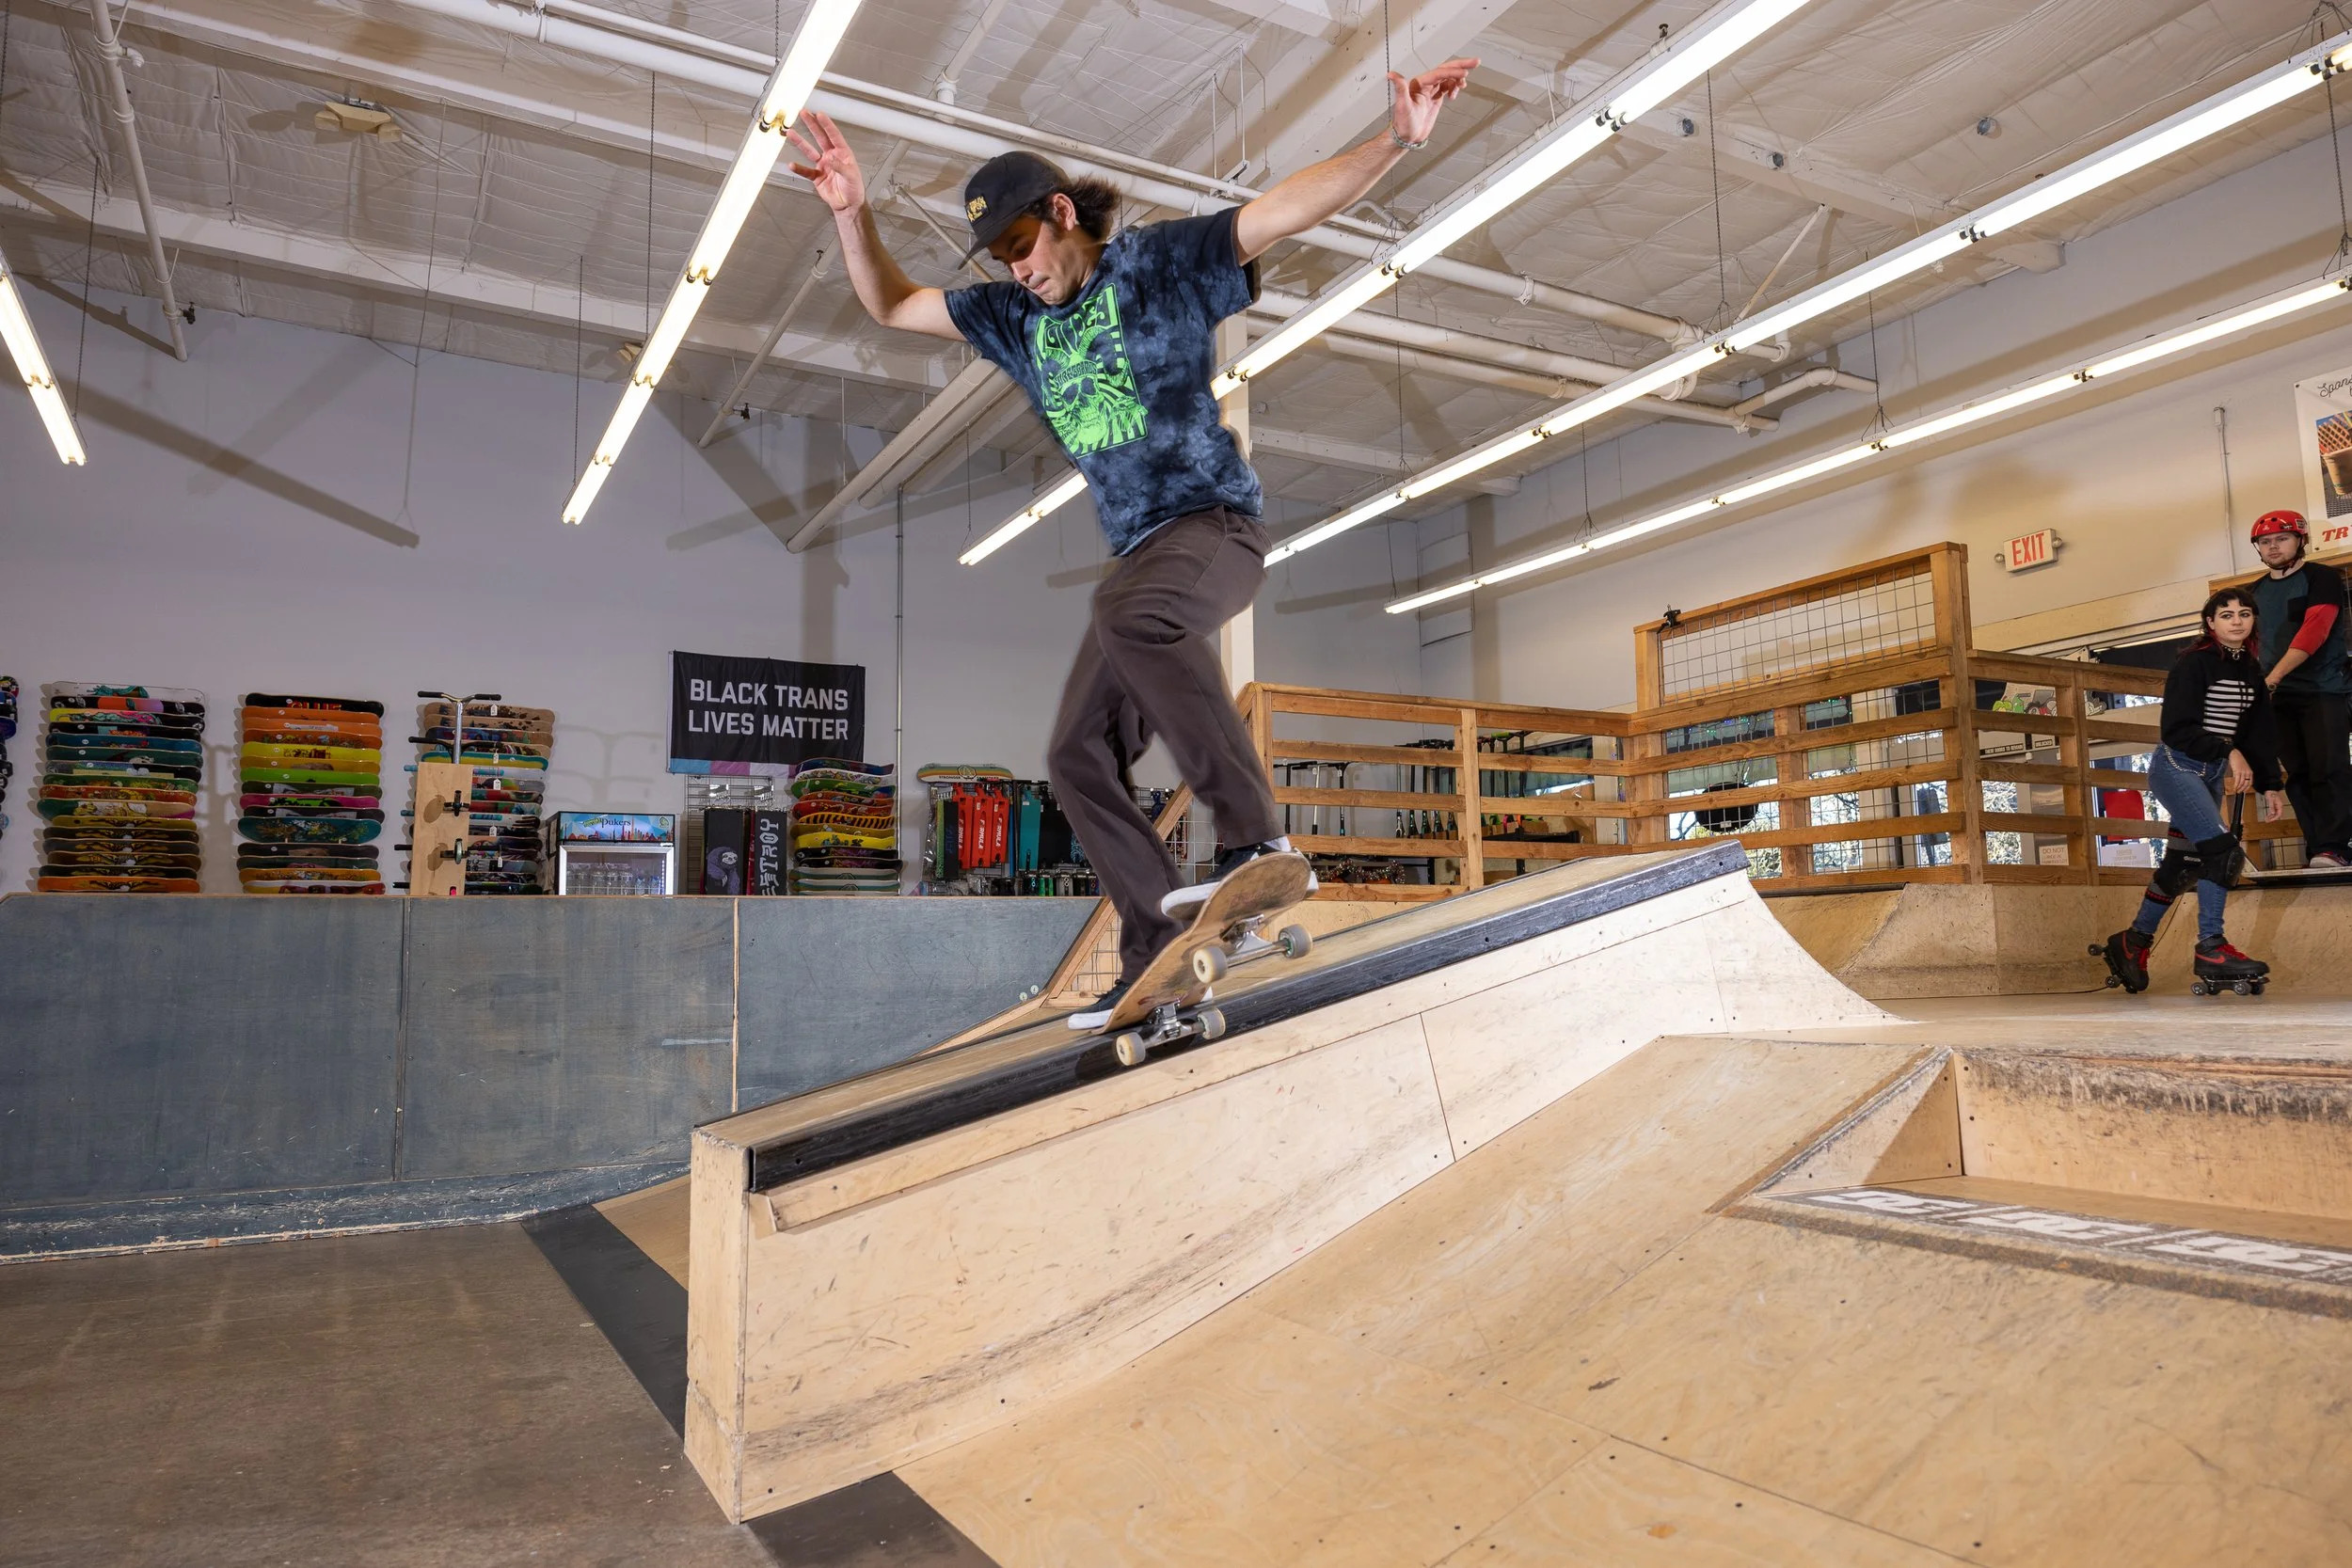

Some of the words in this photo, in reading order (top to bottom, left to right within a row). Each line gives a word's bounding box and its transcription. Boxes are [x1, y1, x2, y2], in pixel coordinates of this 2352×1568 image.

[2011, 531, 2044, 566] EXIT
[2322, 525, 2352, 542] TR
[691, 678, 768, 705] BLACK
[774, 685, 848, 710] TRANS
[689, 710, 755, 735] LIVES
[762, 715, 849, 740] MATTER
[759, 818, 779, 895] ESTROY
